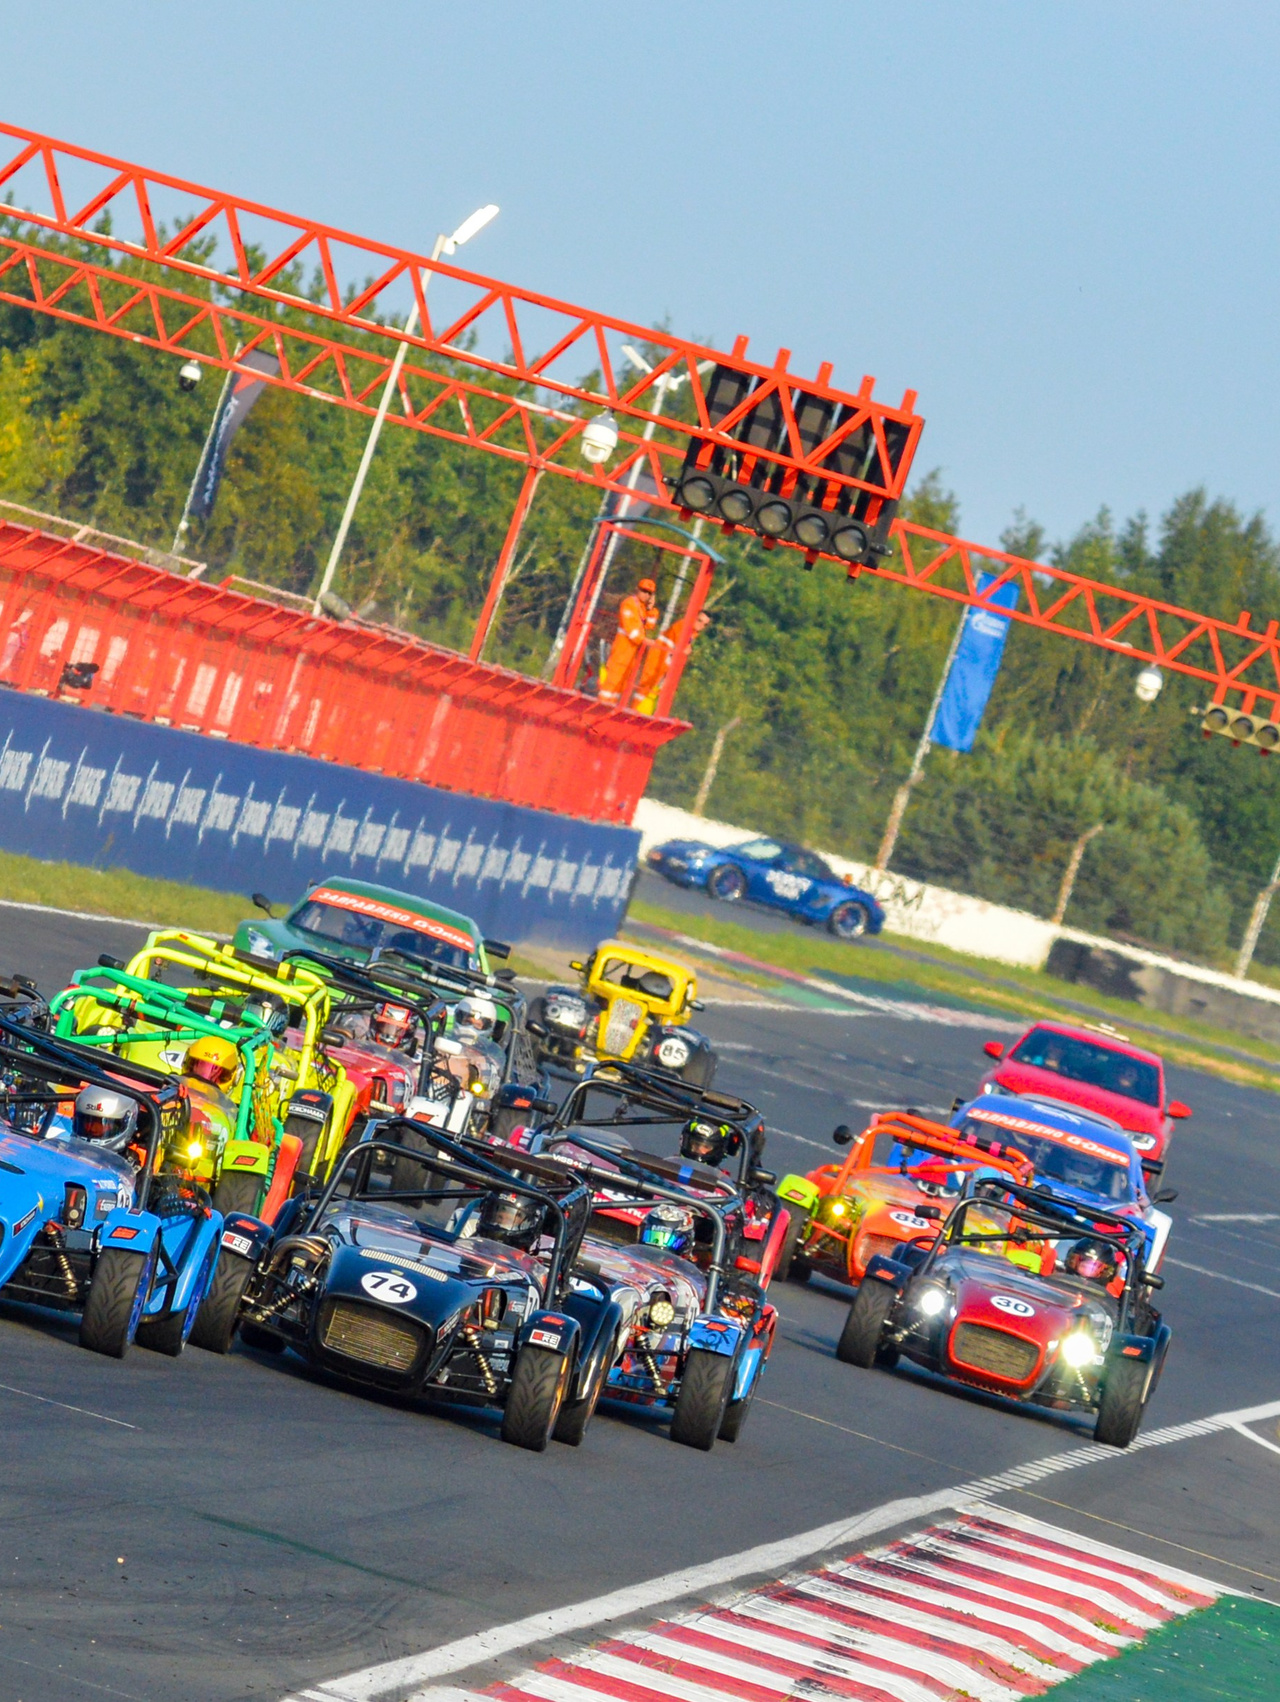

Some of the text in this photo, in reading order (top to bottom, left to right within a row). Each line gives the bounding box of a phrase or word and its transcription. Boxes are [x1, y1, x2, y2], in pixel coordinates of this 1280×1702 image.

[662, 1045, 686, 1060] 85
[370, 1274, 410, 1298] 74
[996, 1297, 1030, 1314] 30
